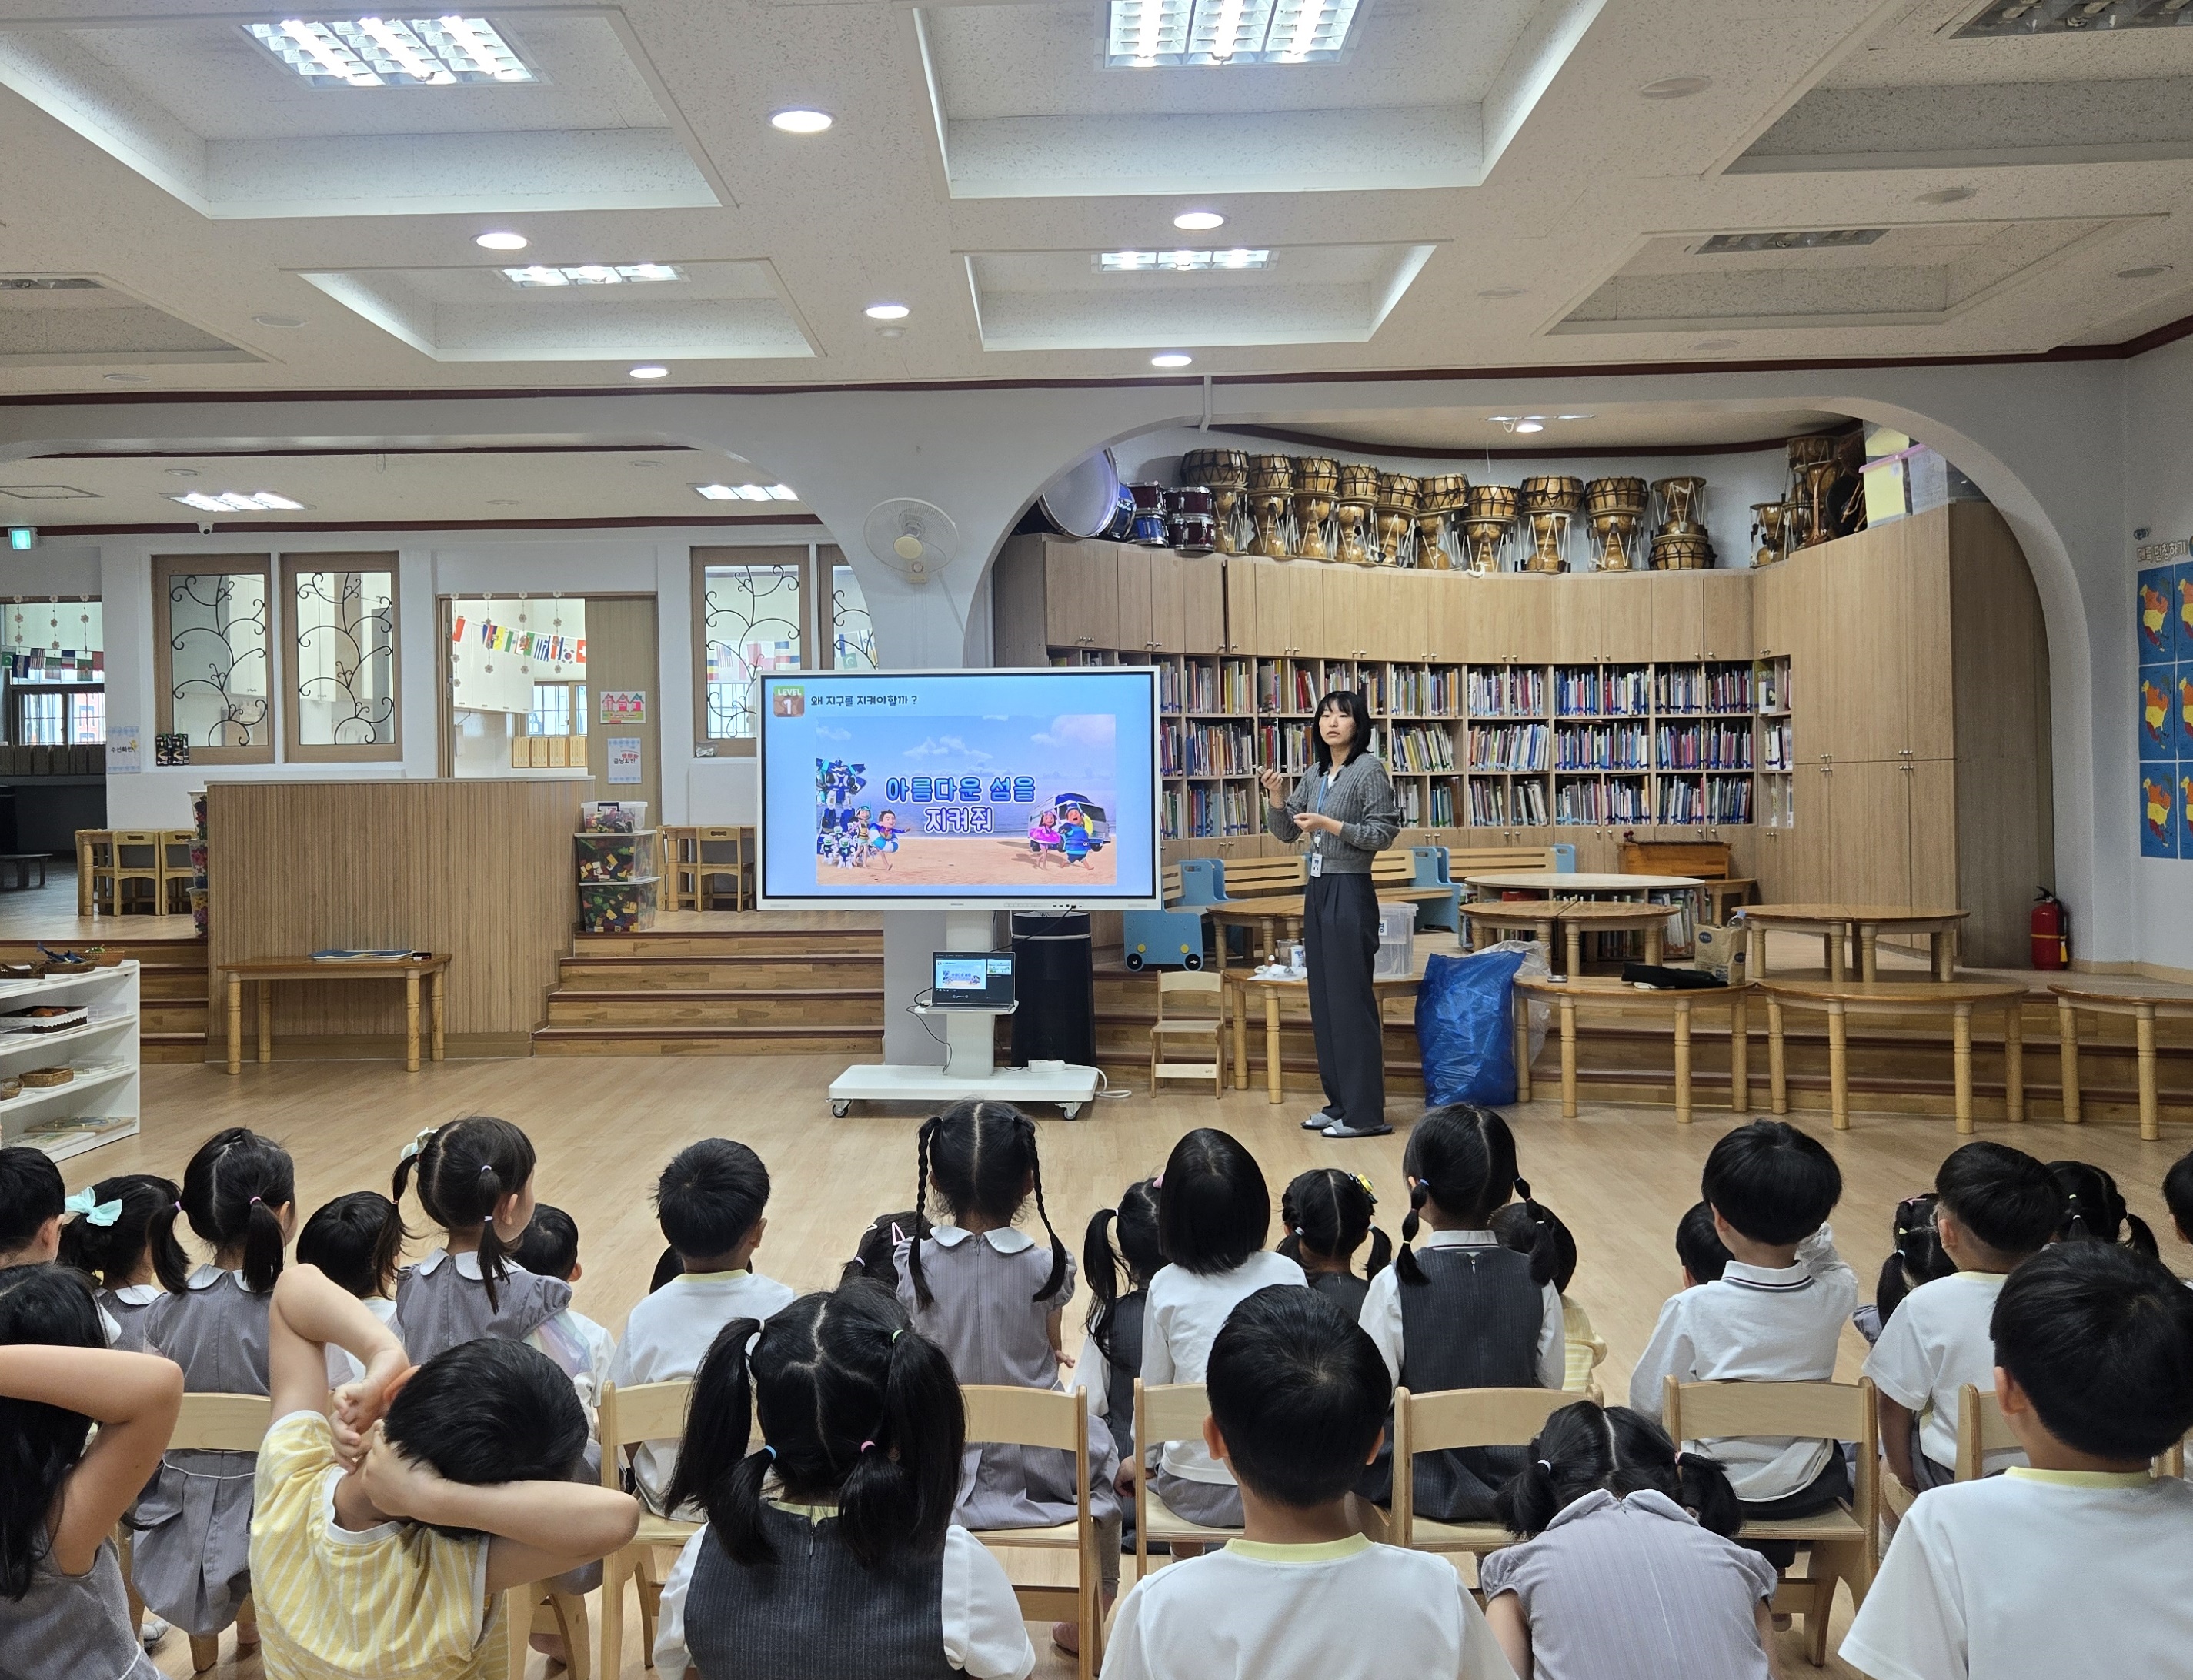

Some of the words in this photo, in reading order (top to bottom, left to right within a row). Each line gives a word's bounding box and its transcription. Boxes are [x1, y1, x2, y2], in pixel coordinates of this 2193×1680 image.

[783, 699, 792, 715] 1
[810, 696, 823, 706] 왜
[826, 696, 853, 707] 지구를
[856, 695, 908, 706] 지켜야할까
[911, 696, 917, 705] ?
[886, 777, 983, 803] 아름다운
[990, 776, 1036, 803] 섬을
[924, 807, 994, 833] 지켜줘
